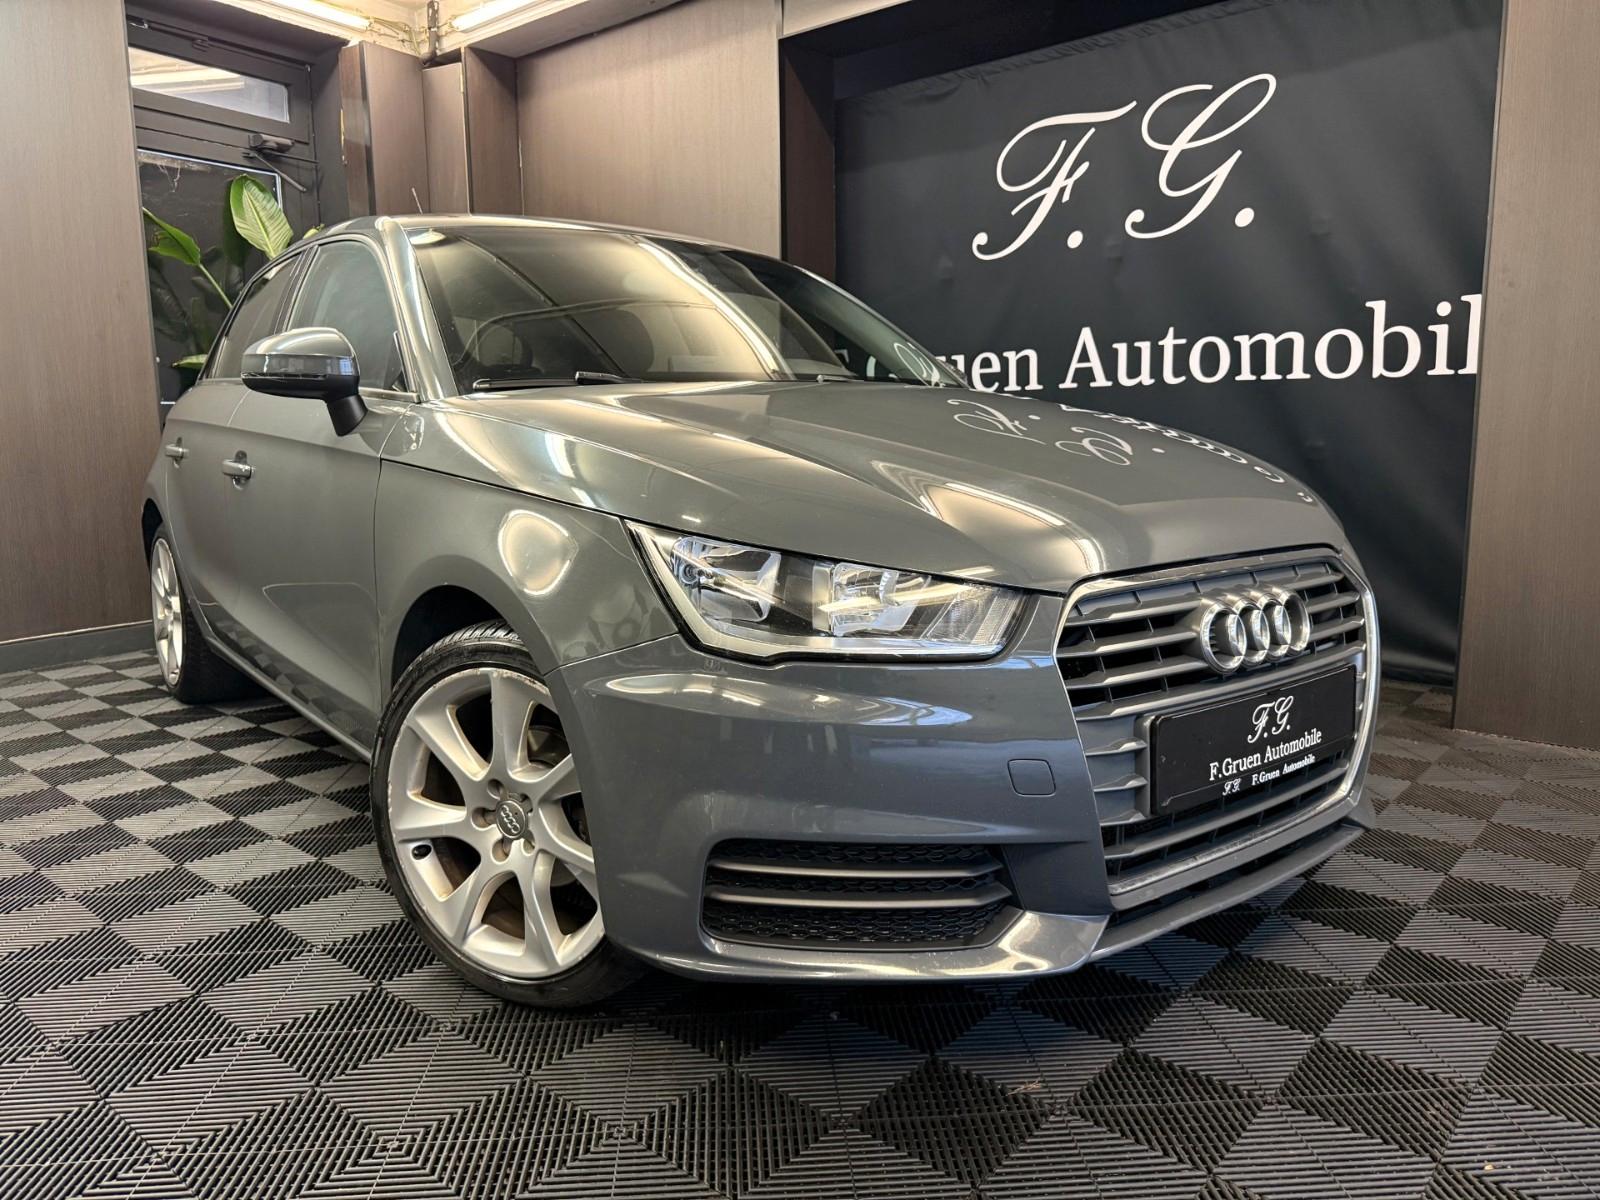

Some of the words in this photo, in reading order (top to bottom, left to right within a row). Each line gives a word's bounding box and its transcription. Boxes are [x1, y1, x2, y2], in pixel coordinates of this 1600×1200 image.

[1209, 753, 1261, 781] F.Gruen
[1264, 728, 1322, 763] Automobile
[1282, 753, 1316, 775] Automobile
